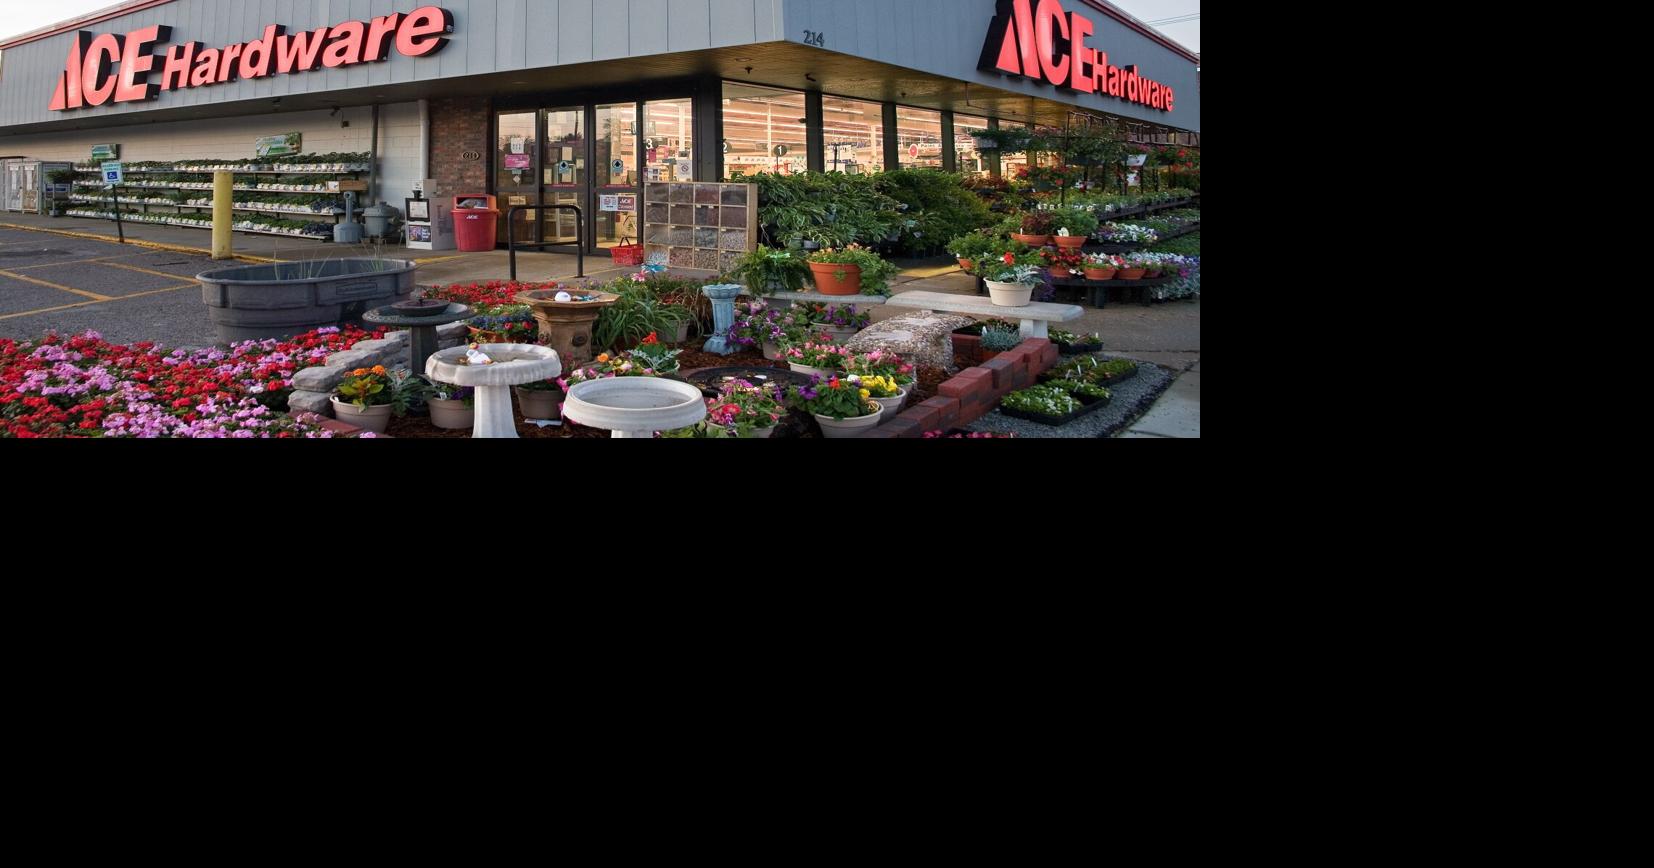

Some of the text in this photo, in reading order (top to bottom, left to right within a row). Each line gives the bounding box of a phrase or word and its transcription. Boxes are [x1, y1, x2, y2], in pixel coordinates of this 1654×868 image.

[48, 5, 446, 111] ACE Hardware
[803, 30, 825, 47] 214
[996, 0, 1175, 112] ACE Hardware
[645, 138, 653, 150] 3
